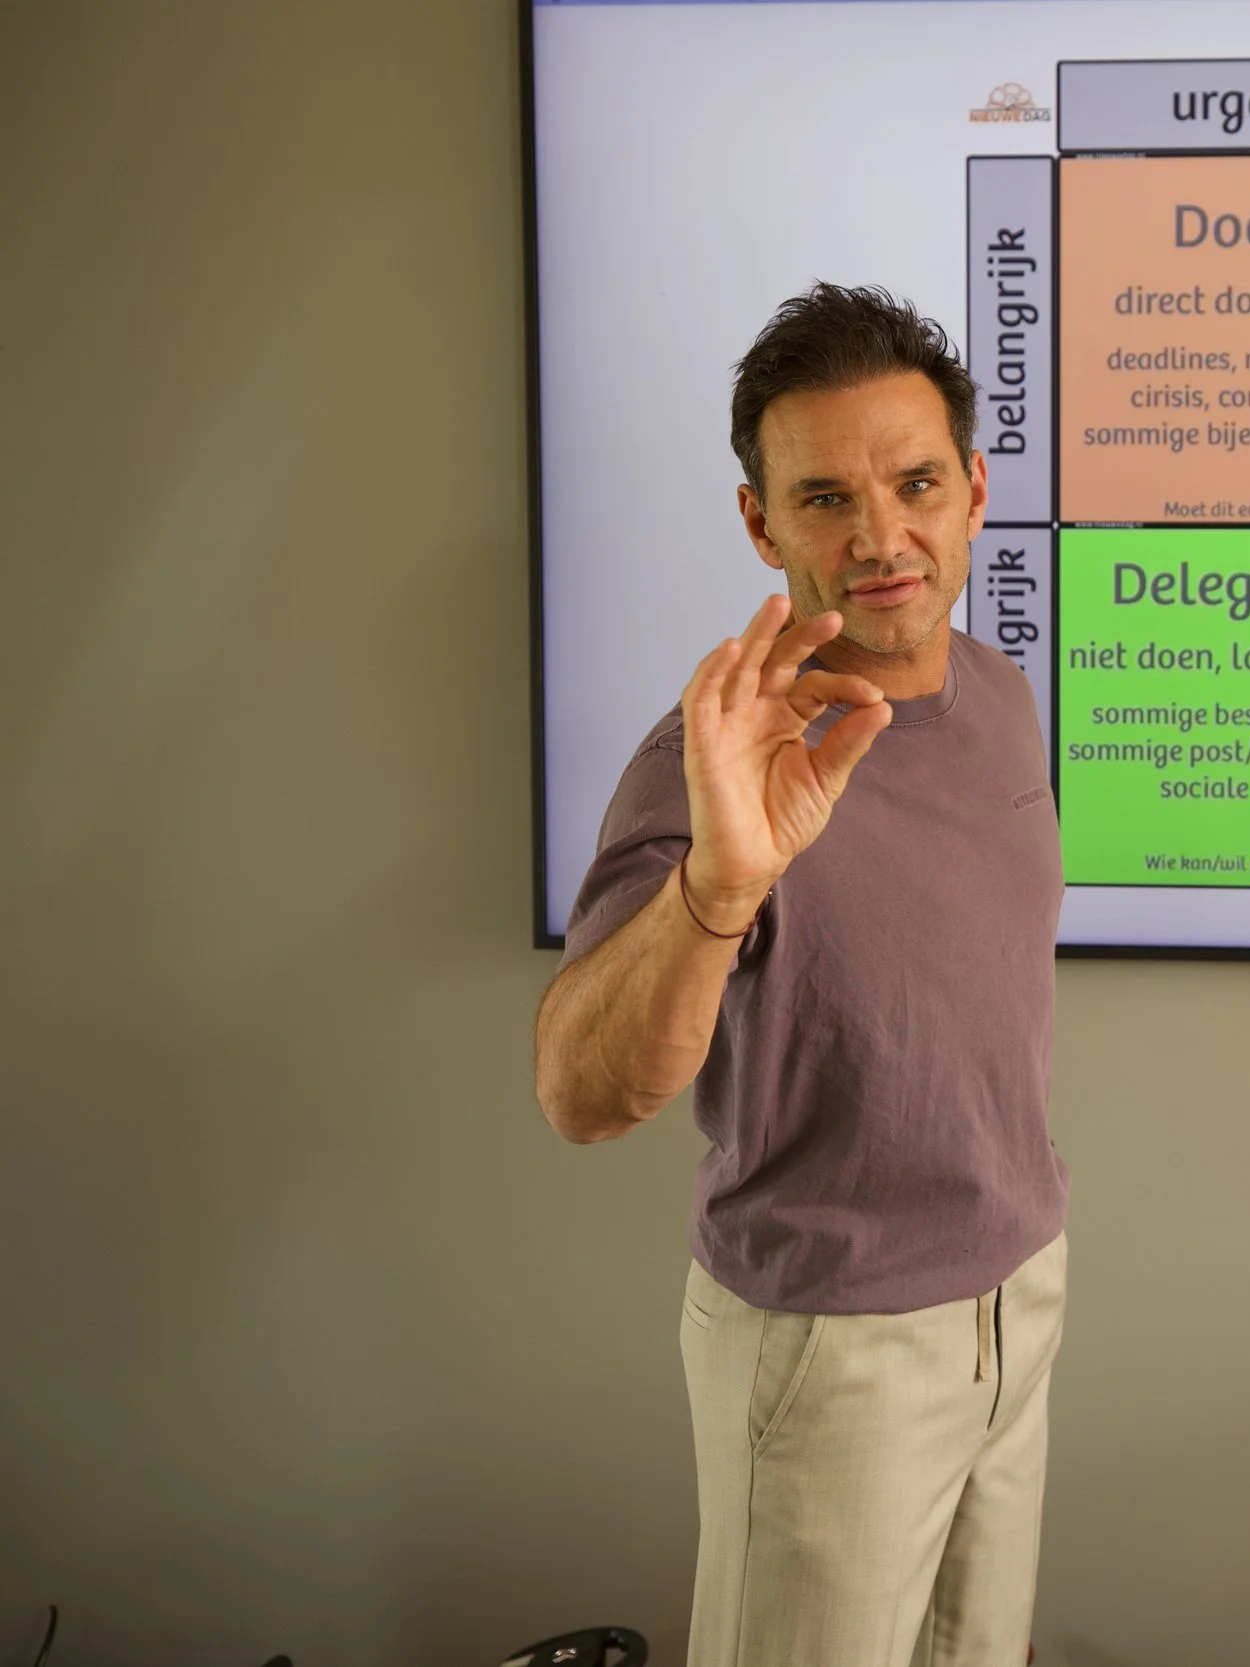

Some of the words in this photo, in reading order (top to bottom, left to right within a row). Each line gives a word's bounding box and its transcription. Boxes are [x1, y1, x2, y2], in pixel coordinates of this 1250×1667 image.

[1114, 285, 1206, 316] direct
[987, 228, 1040, 455] belangrijk
[1106, 345, 1237, 374] deadlines,
[1130, 383, 1210, 412] cirisis,
[1083, 421, 1200, 454] sommige
[1163, 501, 1207, 518] Moet
[1210, 500, 1235, 518] dit
[1069, 640, 1128, 670] niet
[1137, 641, 1222, 676] doen,
[1092, 701, 1208, 734] sommige
[1068, 738, 1183, 770] sommige
[1159, 775, 1250, 800] sociale
[1144, 854, 1177, 871] Wie
[1180, 854, 1247, 872] kan/wil
